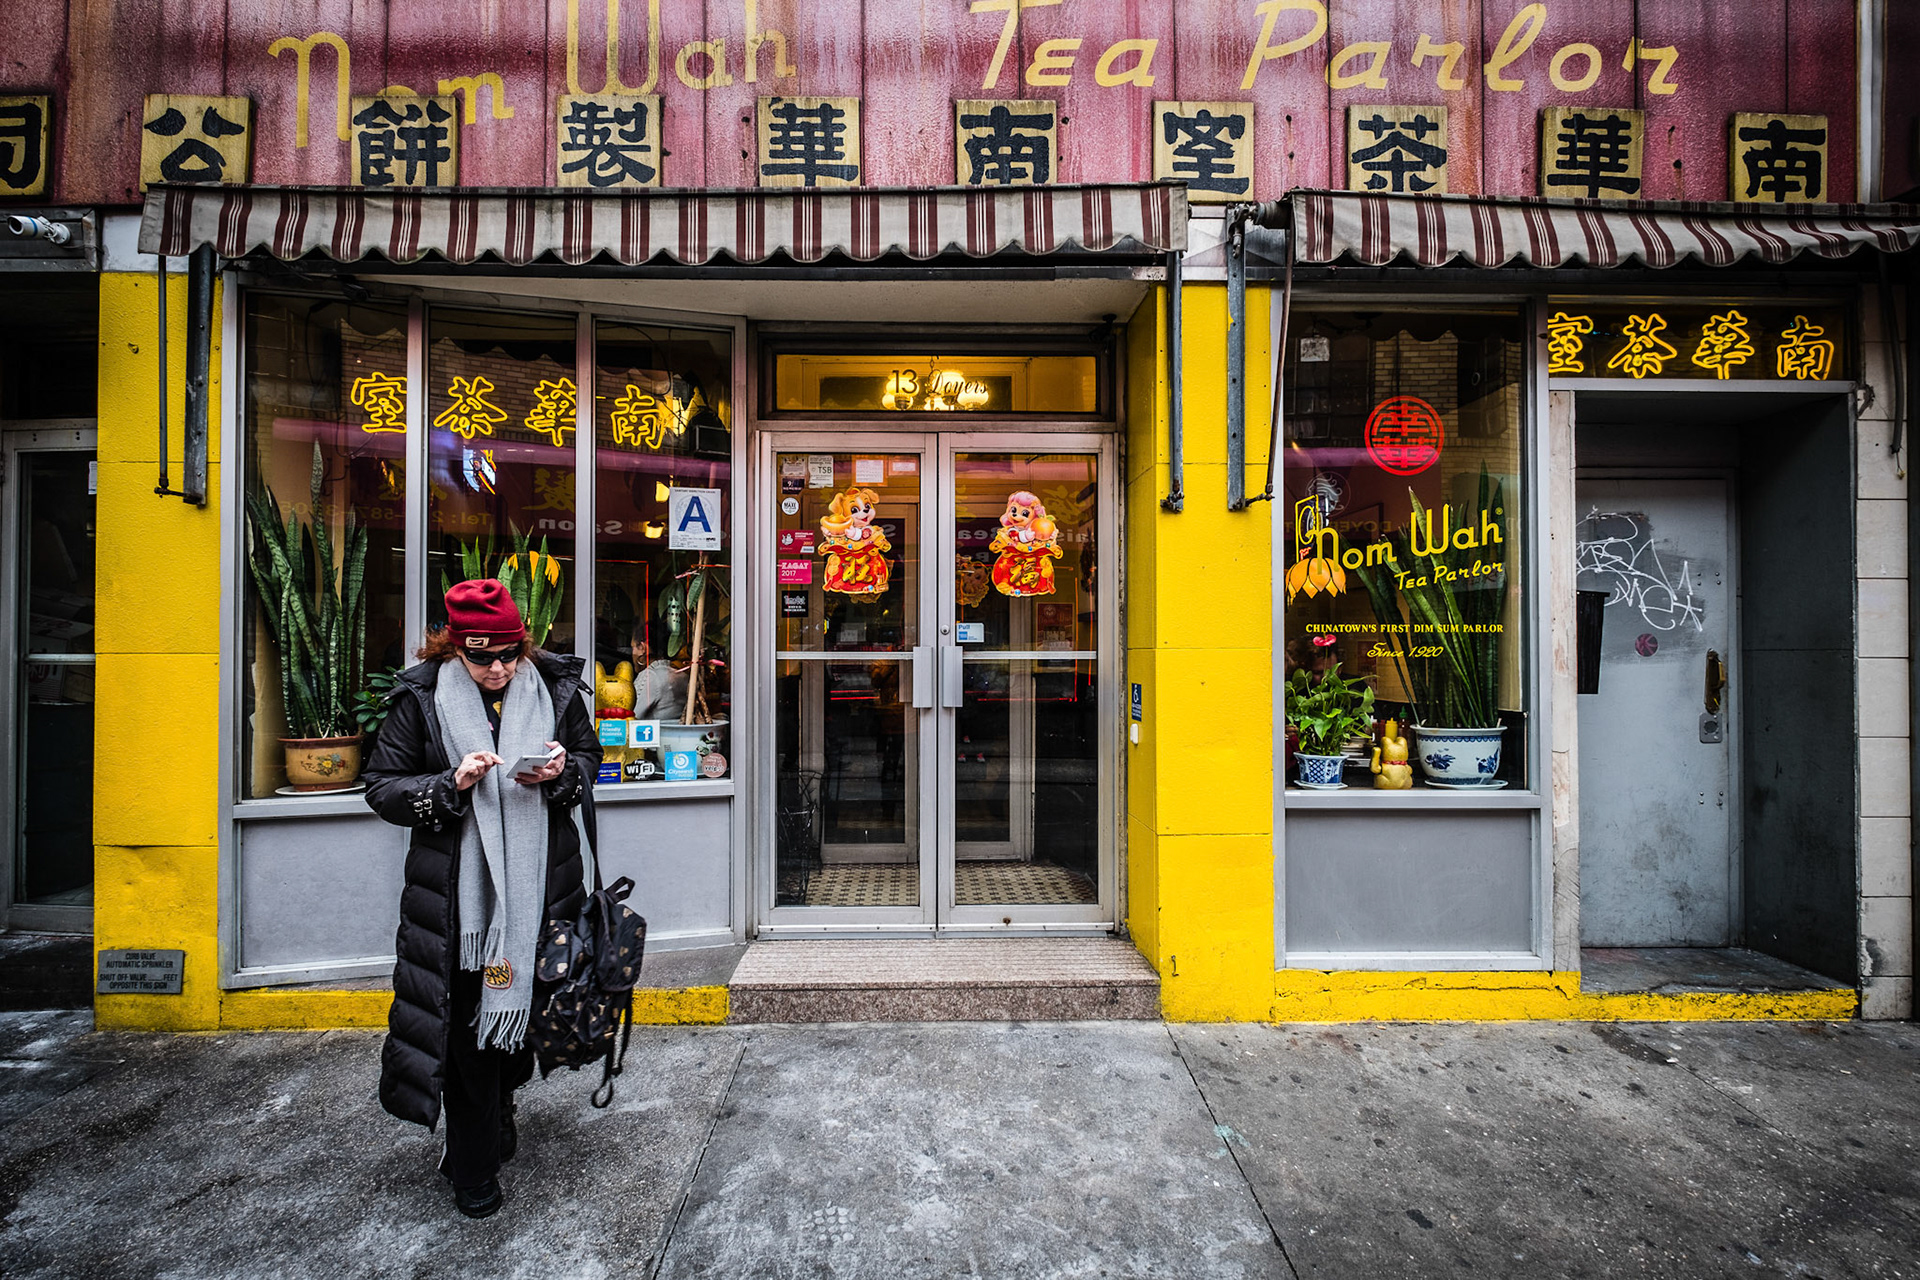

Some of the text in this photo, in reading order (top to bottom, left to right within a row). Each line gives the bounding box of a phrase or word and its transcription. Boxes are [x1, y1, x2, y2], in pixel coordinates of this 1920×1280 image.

[267, 0, 1680, 148] Nm Wah Tea Parlor
[892, 369, 988, 401] 13 Doyers
[818, 466, 833, 474] TSB
[677, 496, 712, 533] A
[1306, 526, 1398, 576] Nom
[1394, 559, 1504, 591] Tea Parlor
[1306, 623, 1504, 633] CHINATOWN'S FIRST DIM SUM PARLOR
[1367, 642, 1444, 658] Since 1920
